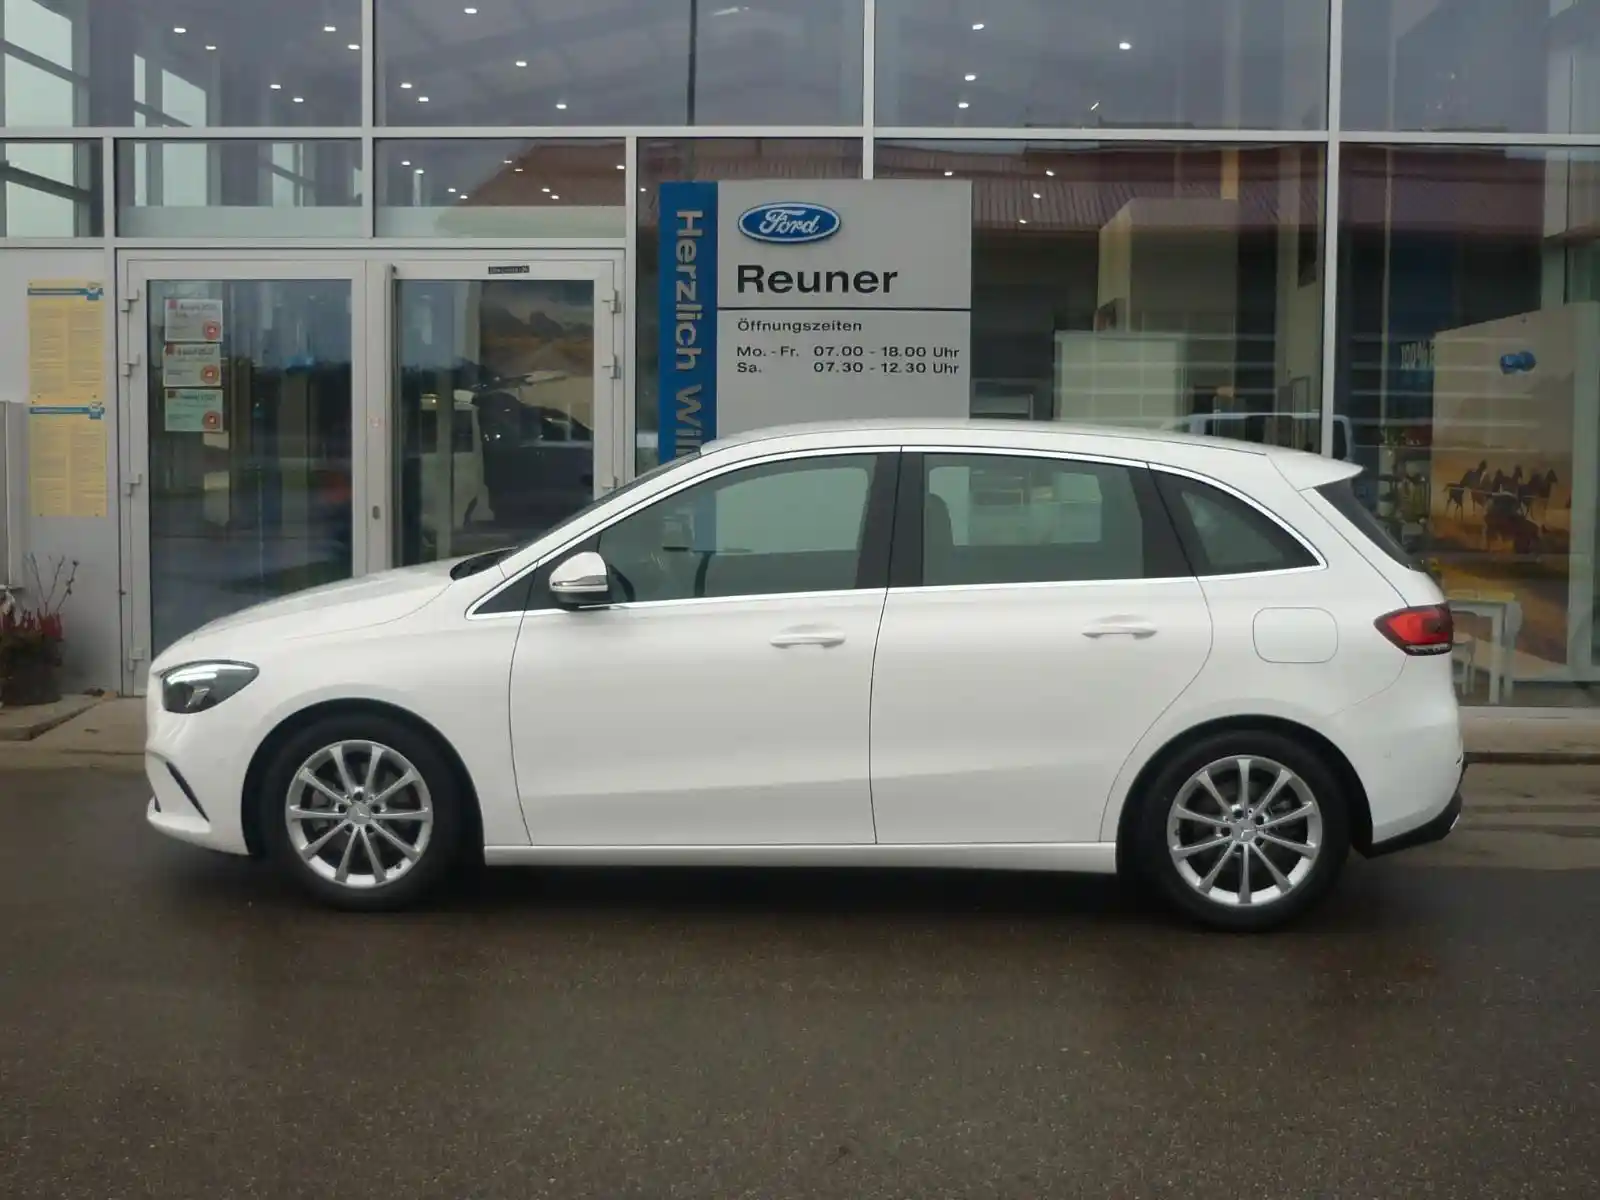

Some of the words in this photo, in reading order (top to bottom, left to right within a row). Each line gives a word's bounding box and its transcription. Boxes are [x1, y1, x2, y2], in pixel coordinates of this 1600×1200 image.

[759, 208, 821, 234] Ford
[737, 264, 899, 294] Reuner
[675, 210, 703, 371] Herzlich
[737, 317, 862, 334] Öffnungszeiten
[736, 345, 767, 357] Mo.
[780, 345, 799, 357] Fr.
[813, 345, 864, 357] 07.00
[881, 346, 927, 358] 18.00
[932, 346, 960, 358] Uhr
[736, 361, 762, 374] Sa.
[813, 361, 864, 373] 07.30
[880, 362, 927, 374] 12.30
[932, 362, 960, 375] Uhr
